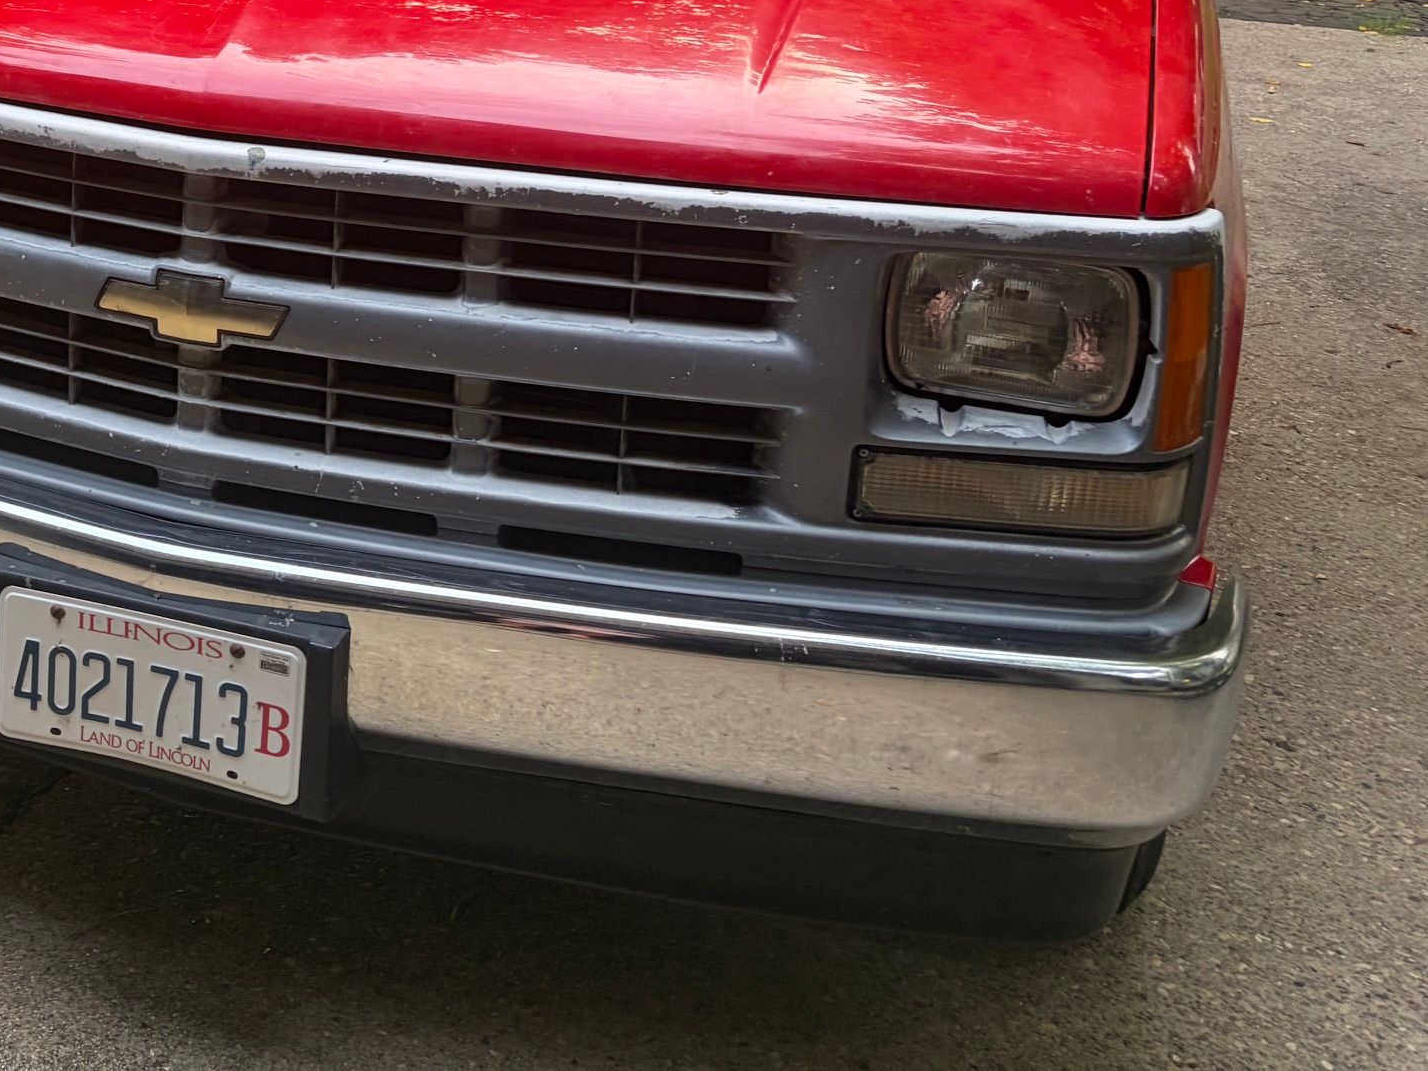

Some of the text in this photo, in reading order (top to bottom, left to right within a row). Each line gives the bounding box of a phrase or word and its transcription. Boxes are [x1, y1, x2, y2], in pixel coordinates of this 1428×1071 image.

[78, 611, 223, 658] ILLINOIS
[80, 725, 211, 772] LAND OF LINCOLN
